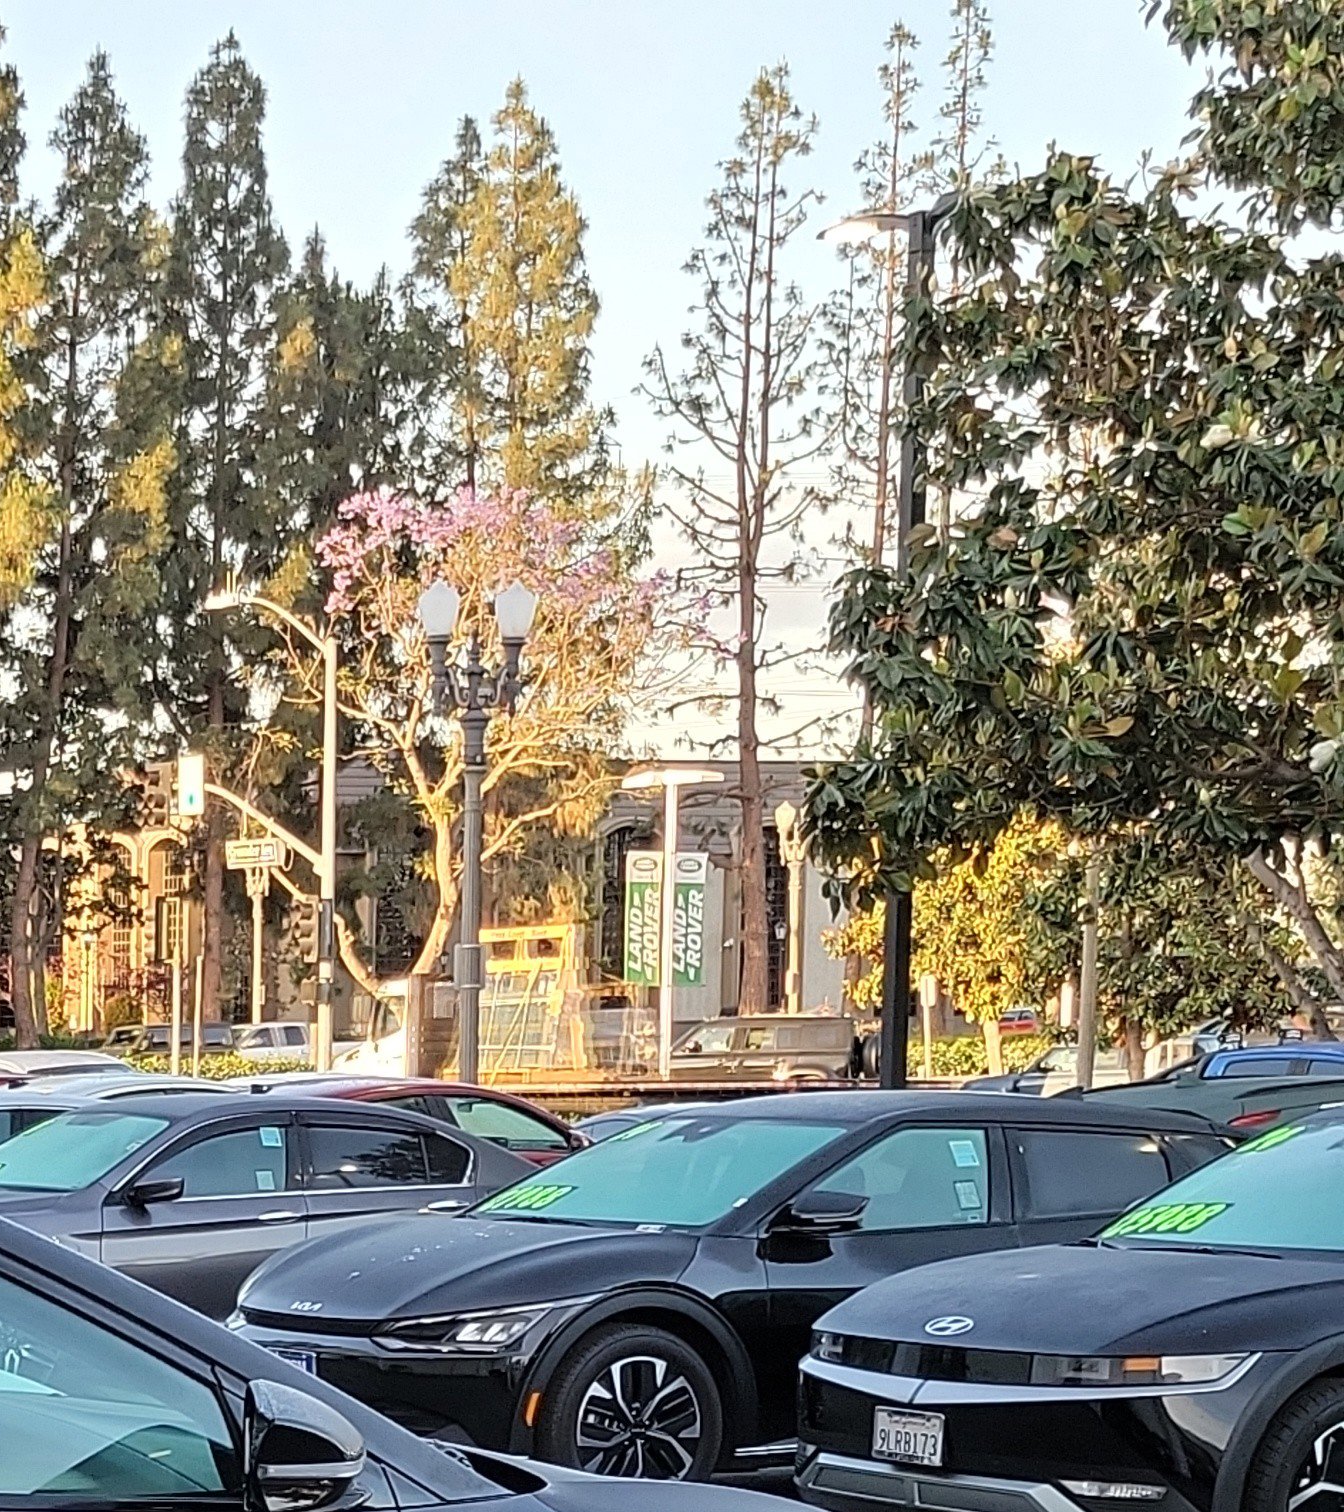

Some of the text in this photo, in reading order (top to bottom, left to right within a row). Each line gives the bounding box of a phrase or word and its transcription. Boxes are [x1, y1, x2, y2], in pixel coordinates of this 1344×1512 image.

[628, 907, 643, 973] LAND
[643, 887, 660, 969] ROVER
[673, 907, 687, 973] LAND
[686, 889, 704, 969] ROVER
[879, 1428, 938, 1457] 9LRB173
